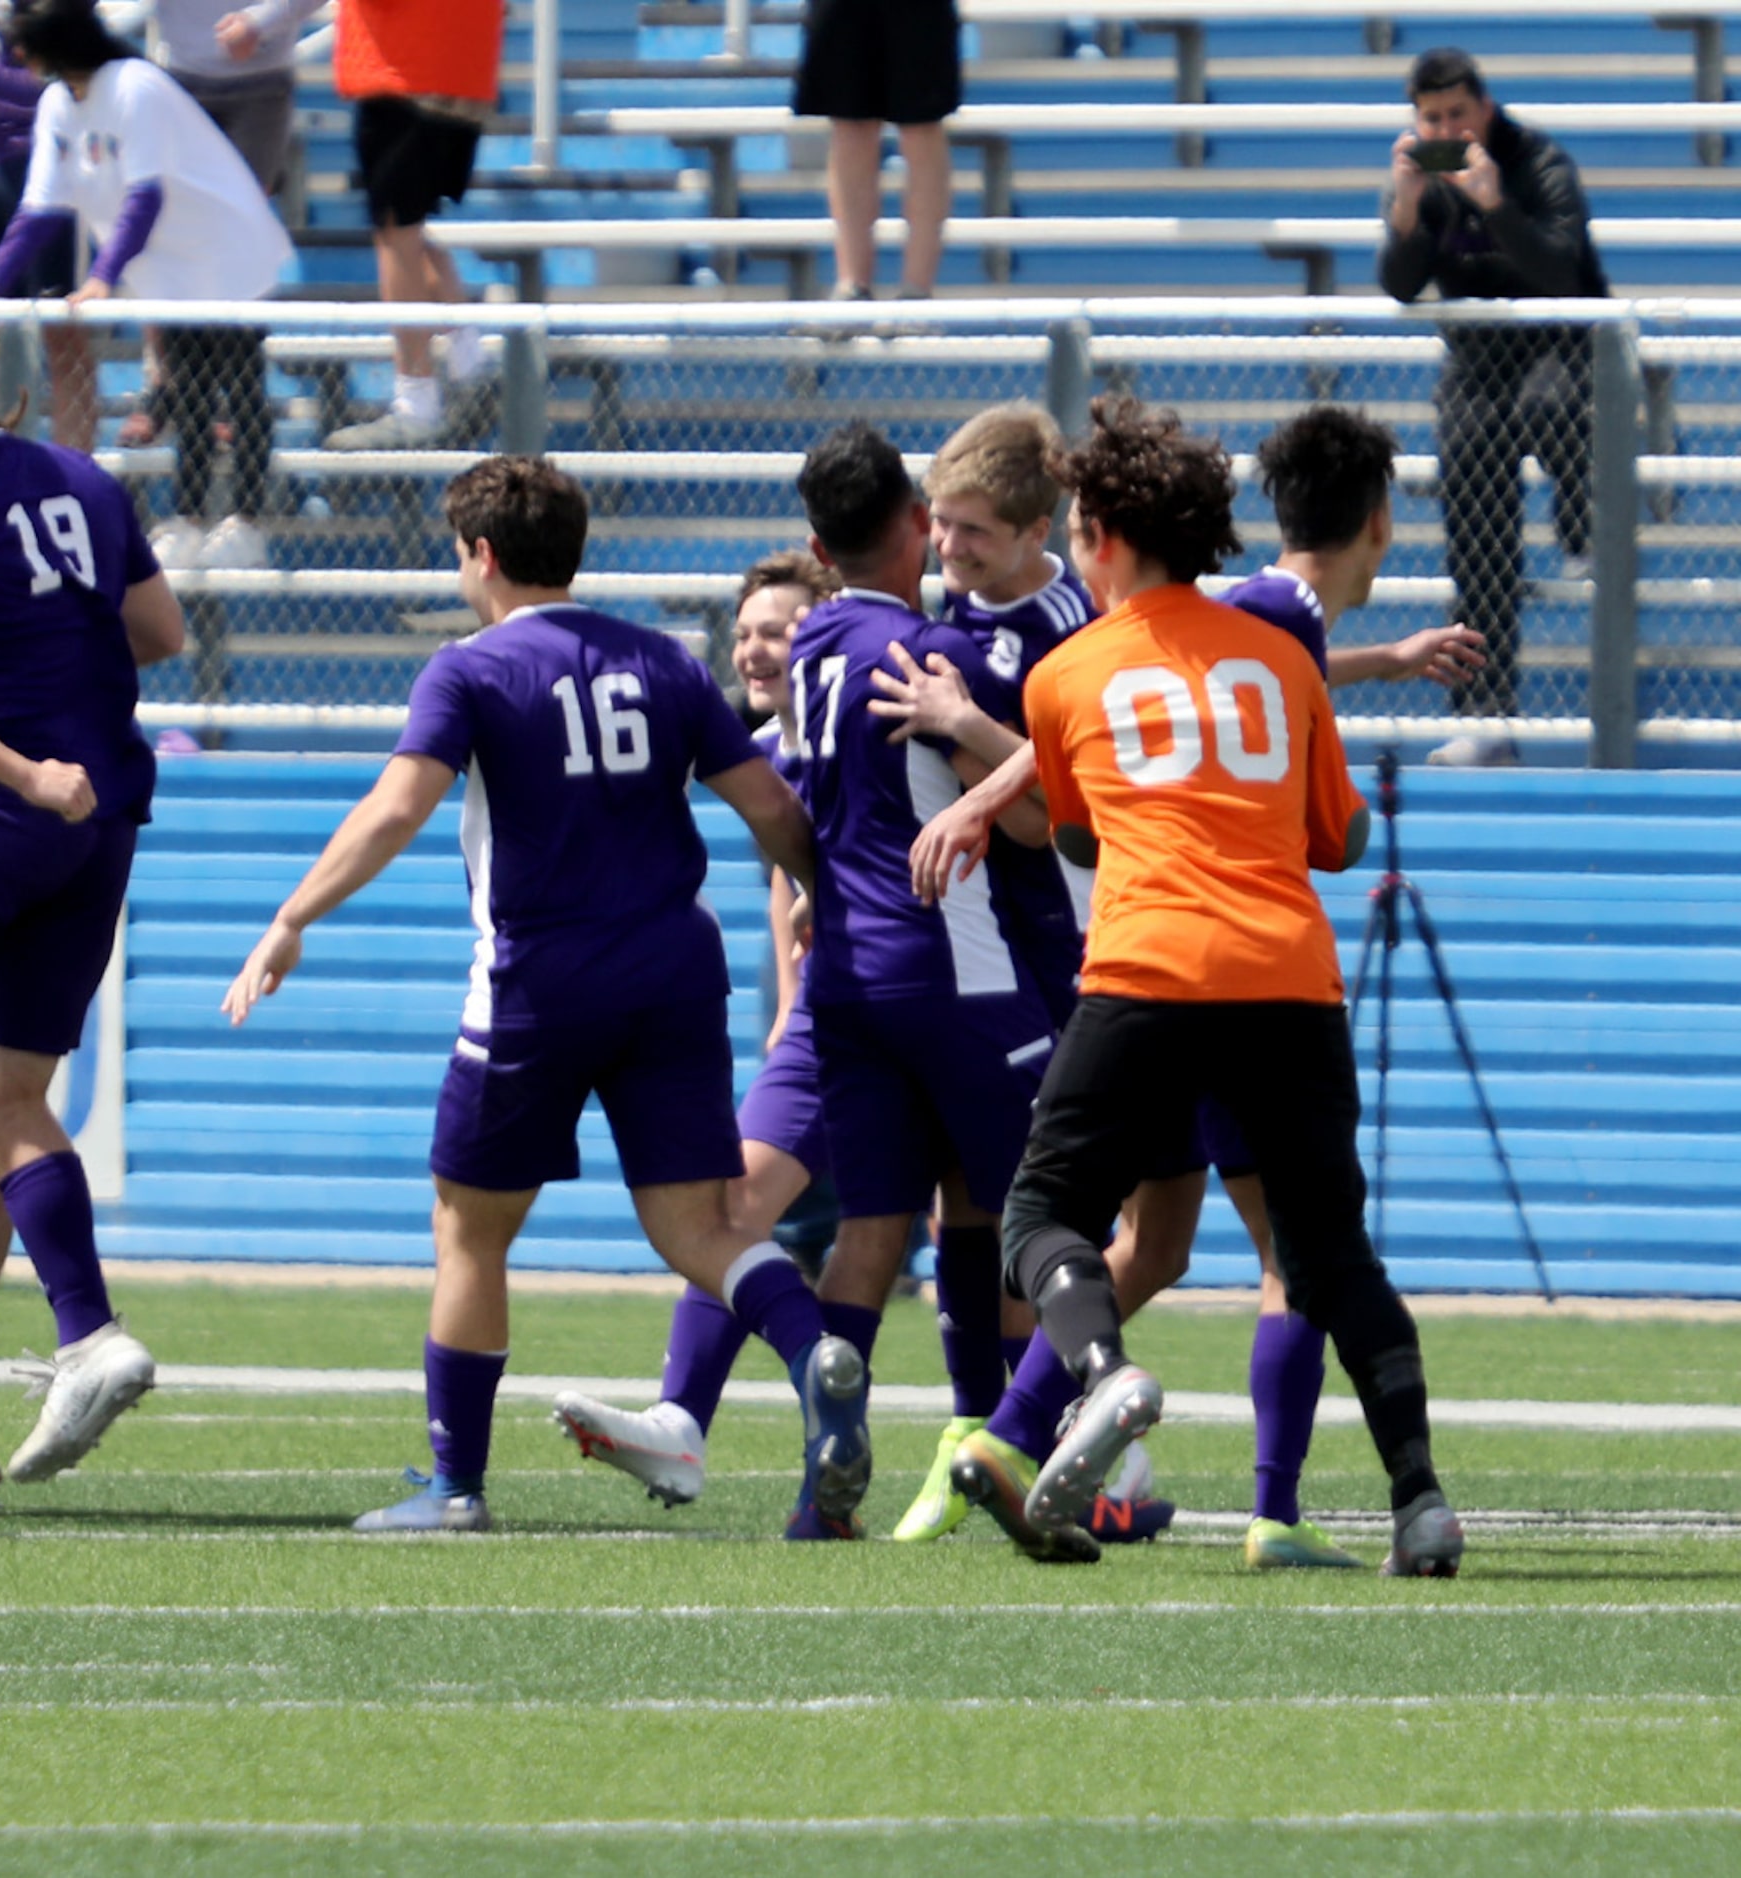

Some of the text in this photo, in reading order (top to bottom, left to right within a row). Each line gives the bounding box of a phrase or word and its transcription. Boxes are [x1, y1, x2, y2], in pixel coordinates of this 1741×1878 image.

[6, 494, 97, 594] 19
[551, 671, 650, 775] 16
[789, 653, 849, 760] 17
[1100, 658, 1291, 788] 00
[1092, 1495, 1131, 1531] N
